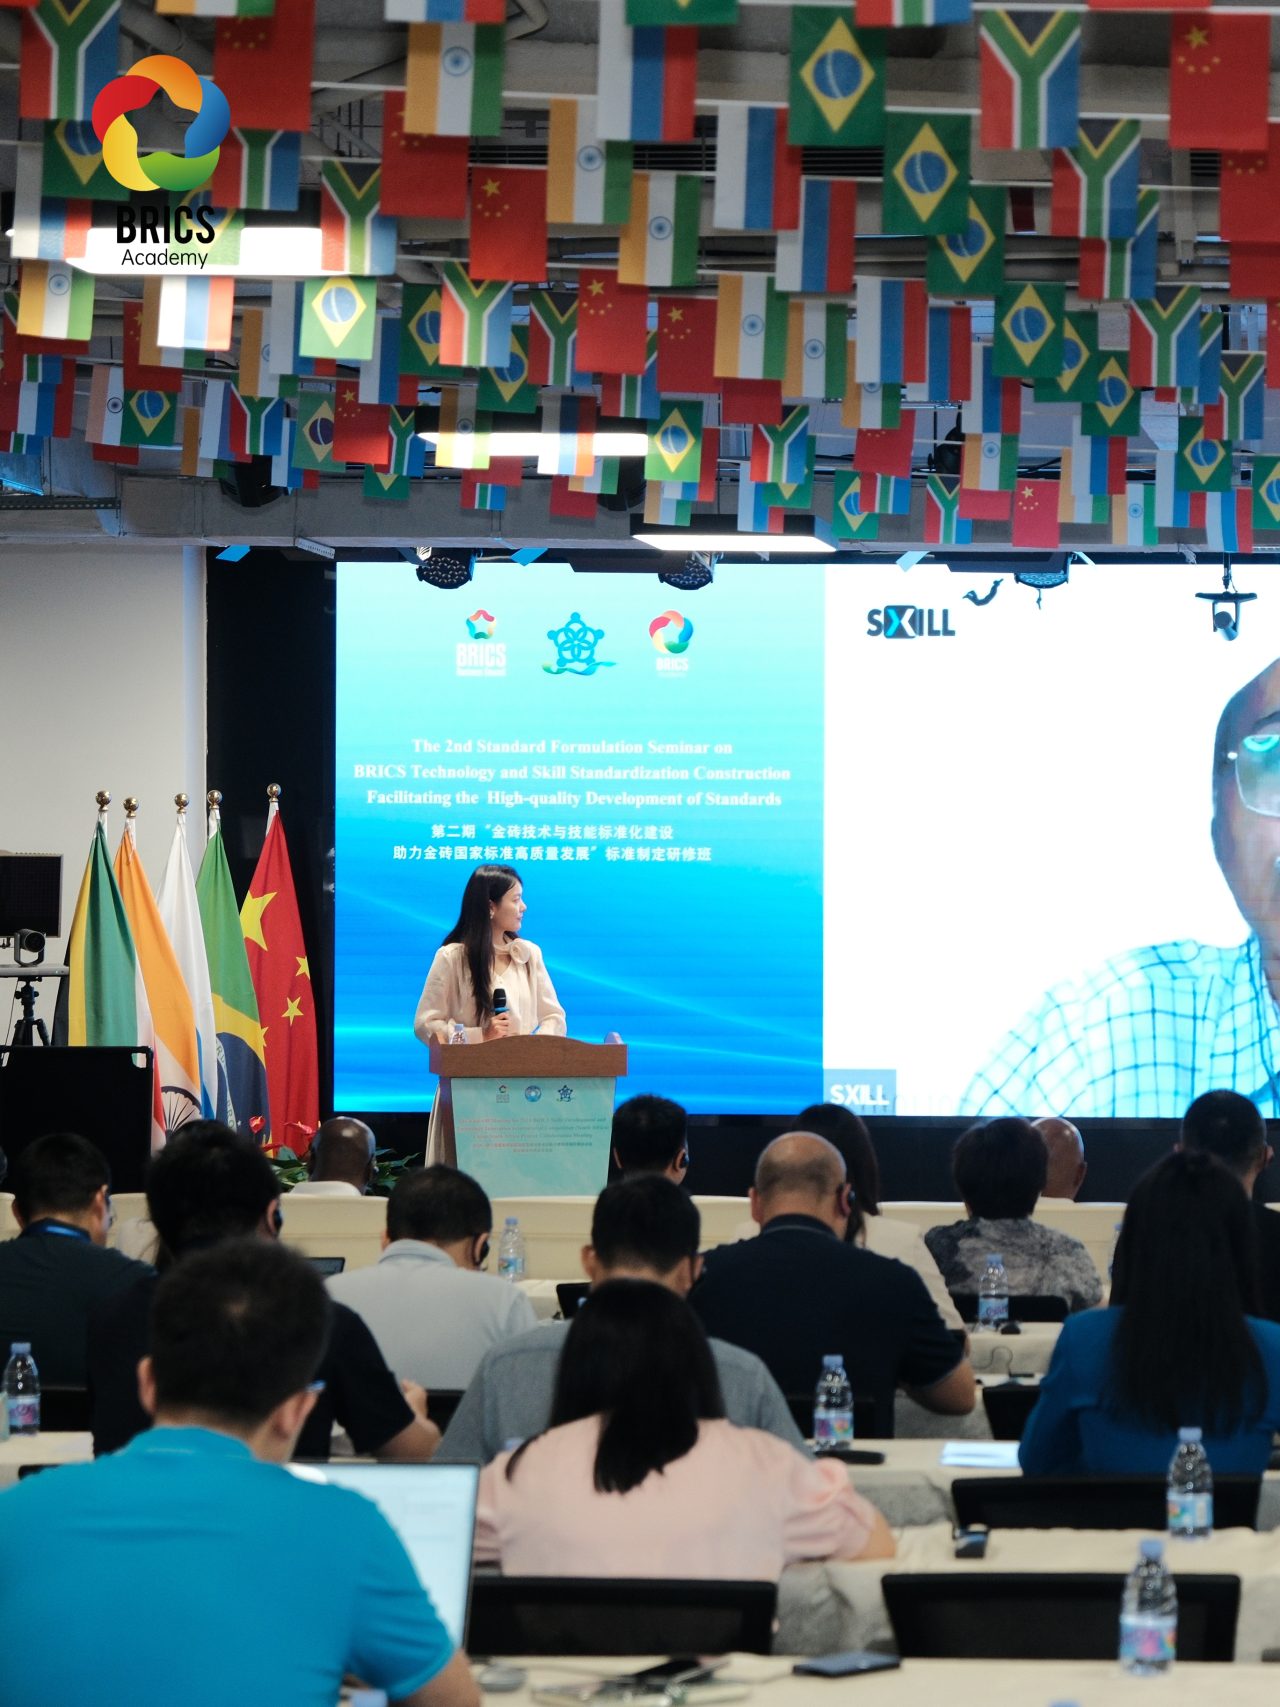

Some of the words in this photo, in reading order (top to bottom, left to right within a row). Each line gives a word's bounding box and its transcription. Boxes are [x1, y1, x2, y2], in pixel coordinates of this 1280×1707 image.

[456, 643, 506, 667] BRICS
[656, 657, 689, 671] BRICS
[412, 739, 441, 753] The
[445, 739, 473, 753] 2nd
[477, 740, 547, 753] Standard
[551, 740, 644, 753] Formulation
[647, 741, 710, 754] Seminar
[714, 744, 733, 754] on
[354, 764, 407, 779] BRICS
[411, 764, 495, 782] Technology
[500, 766, 529, 779] and
[532, 765, 567, 780] Skill
[570, 766, 690, 780] Standardization
[693, 766, 791, 780] Construction
[367, 789, 452, 808] Facilitating
[455, 790, 480, 805] the
[487, 790, 581, 808] High-quality
[585, 790, 683, 808] Development
[686, 791, 703, 805] of
[705, 791, 782, 806] Standards
